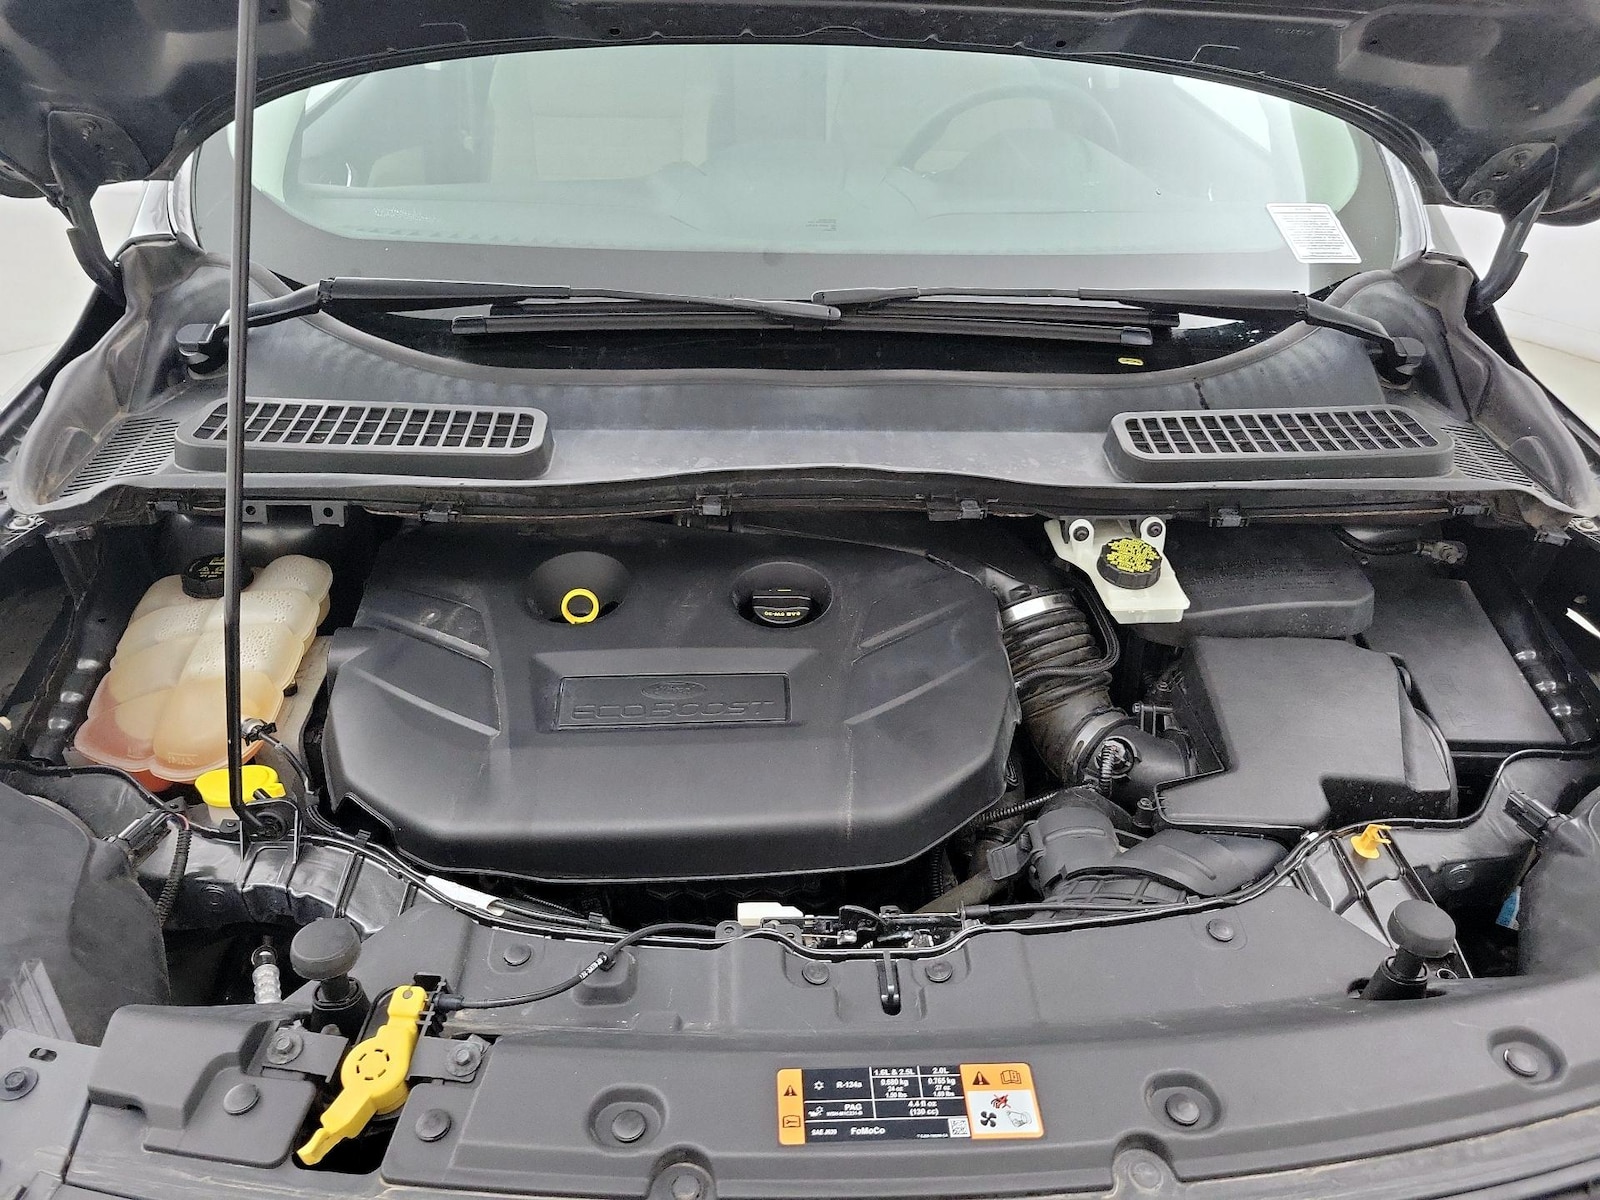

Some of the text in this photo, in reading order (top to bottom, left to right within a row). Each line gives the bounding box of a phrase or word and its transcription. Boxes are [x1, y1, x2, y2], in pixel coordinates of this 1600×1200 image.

[570, 701, 774, 719] ECOBOOST
[932, 1067, 950, 1075] 2.0L
[835, 1080, 864, 1089] R-134a
[900, 1078, 909, 1088] kg
[928, 1077, 956, 1087] 0.765 kg
[844, 1103, 863, 1111] PAG
[850, 1126, 886, 1136] FoMoCo
